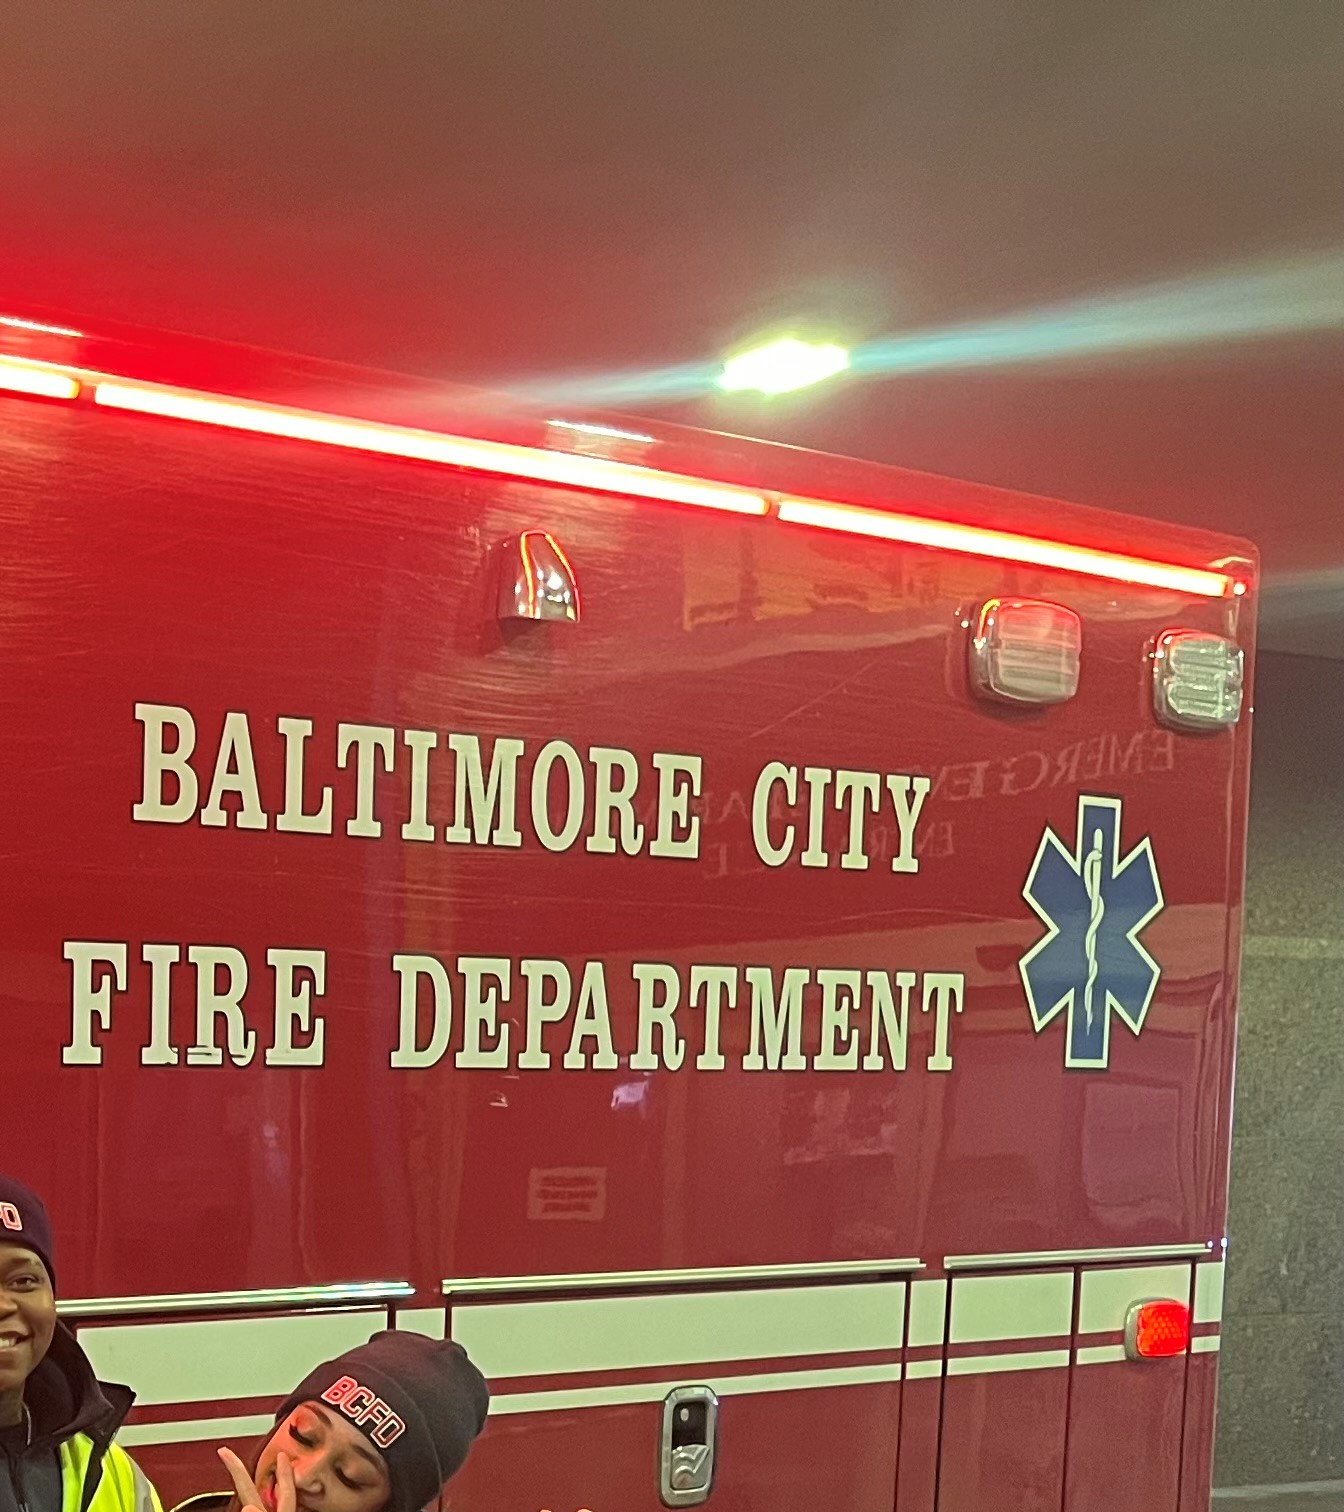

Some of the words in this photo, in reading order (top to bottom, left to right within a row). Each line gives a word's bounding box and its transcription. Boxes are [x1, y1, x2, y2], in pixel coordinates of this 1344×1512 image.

[132, 702, 703, 860] BALTIMORE
[751, 760, 932, 873] CITY
[61, 940, 327, 1066] FIRE
[390, 953, 965, 1071] DEPARTMENT
[320, 1375, 407, 1449] BCFD
